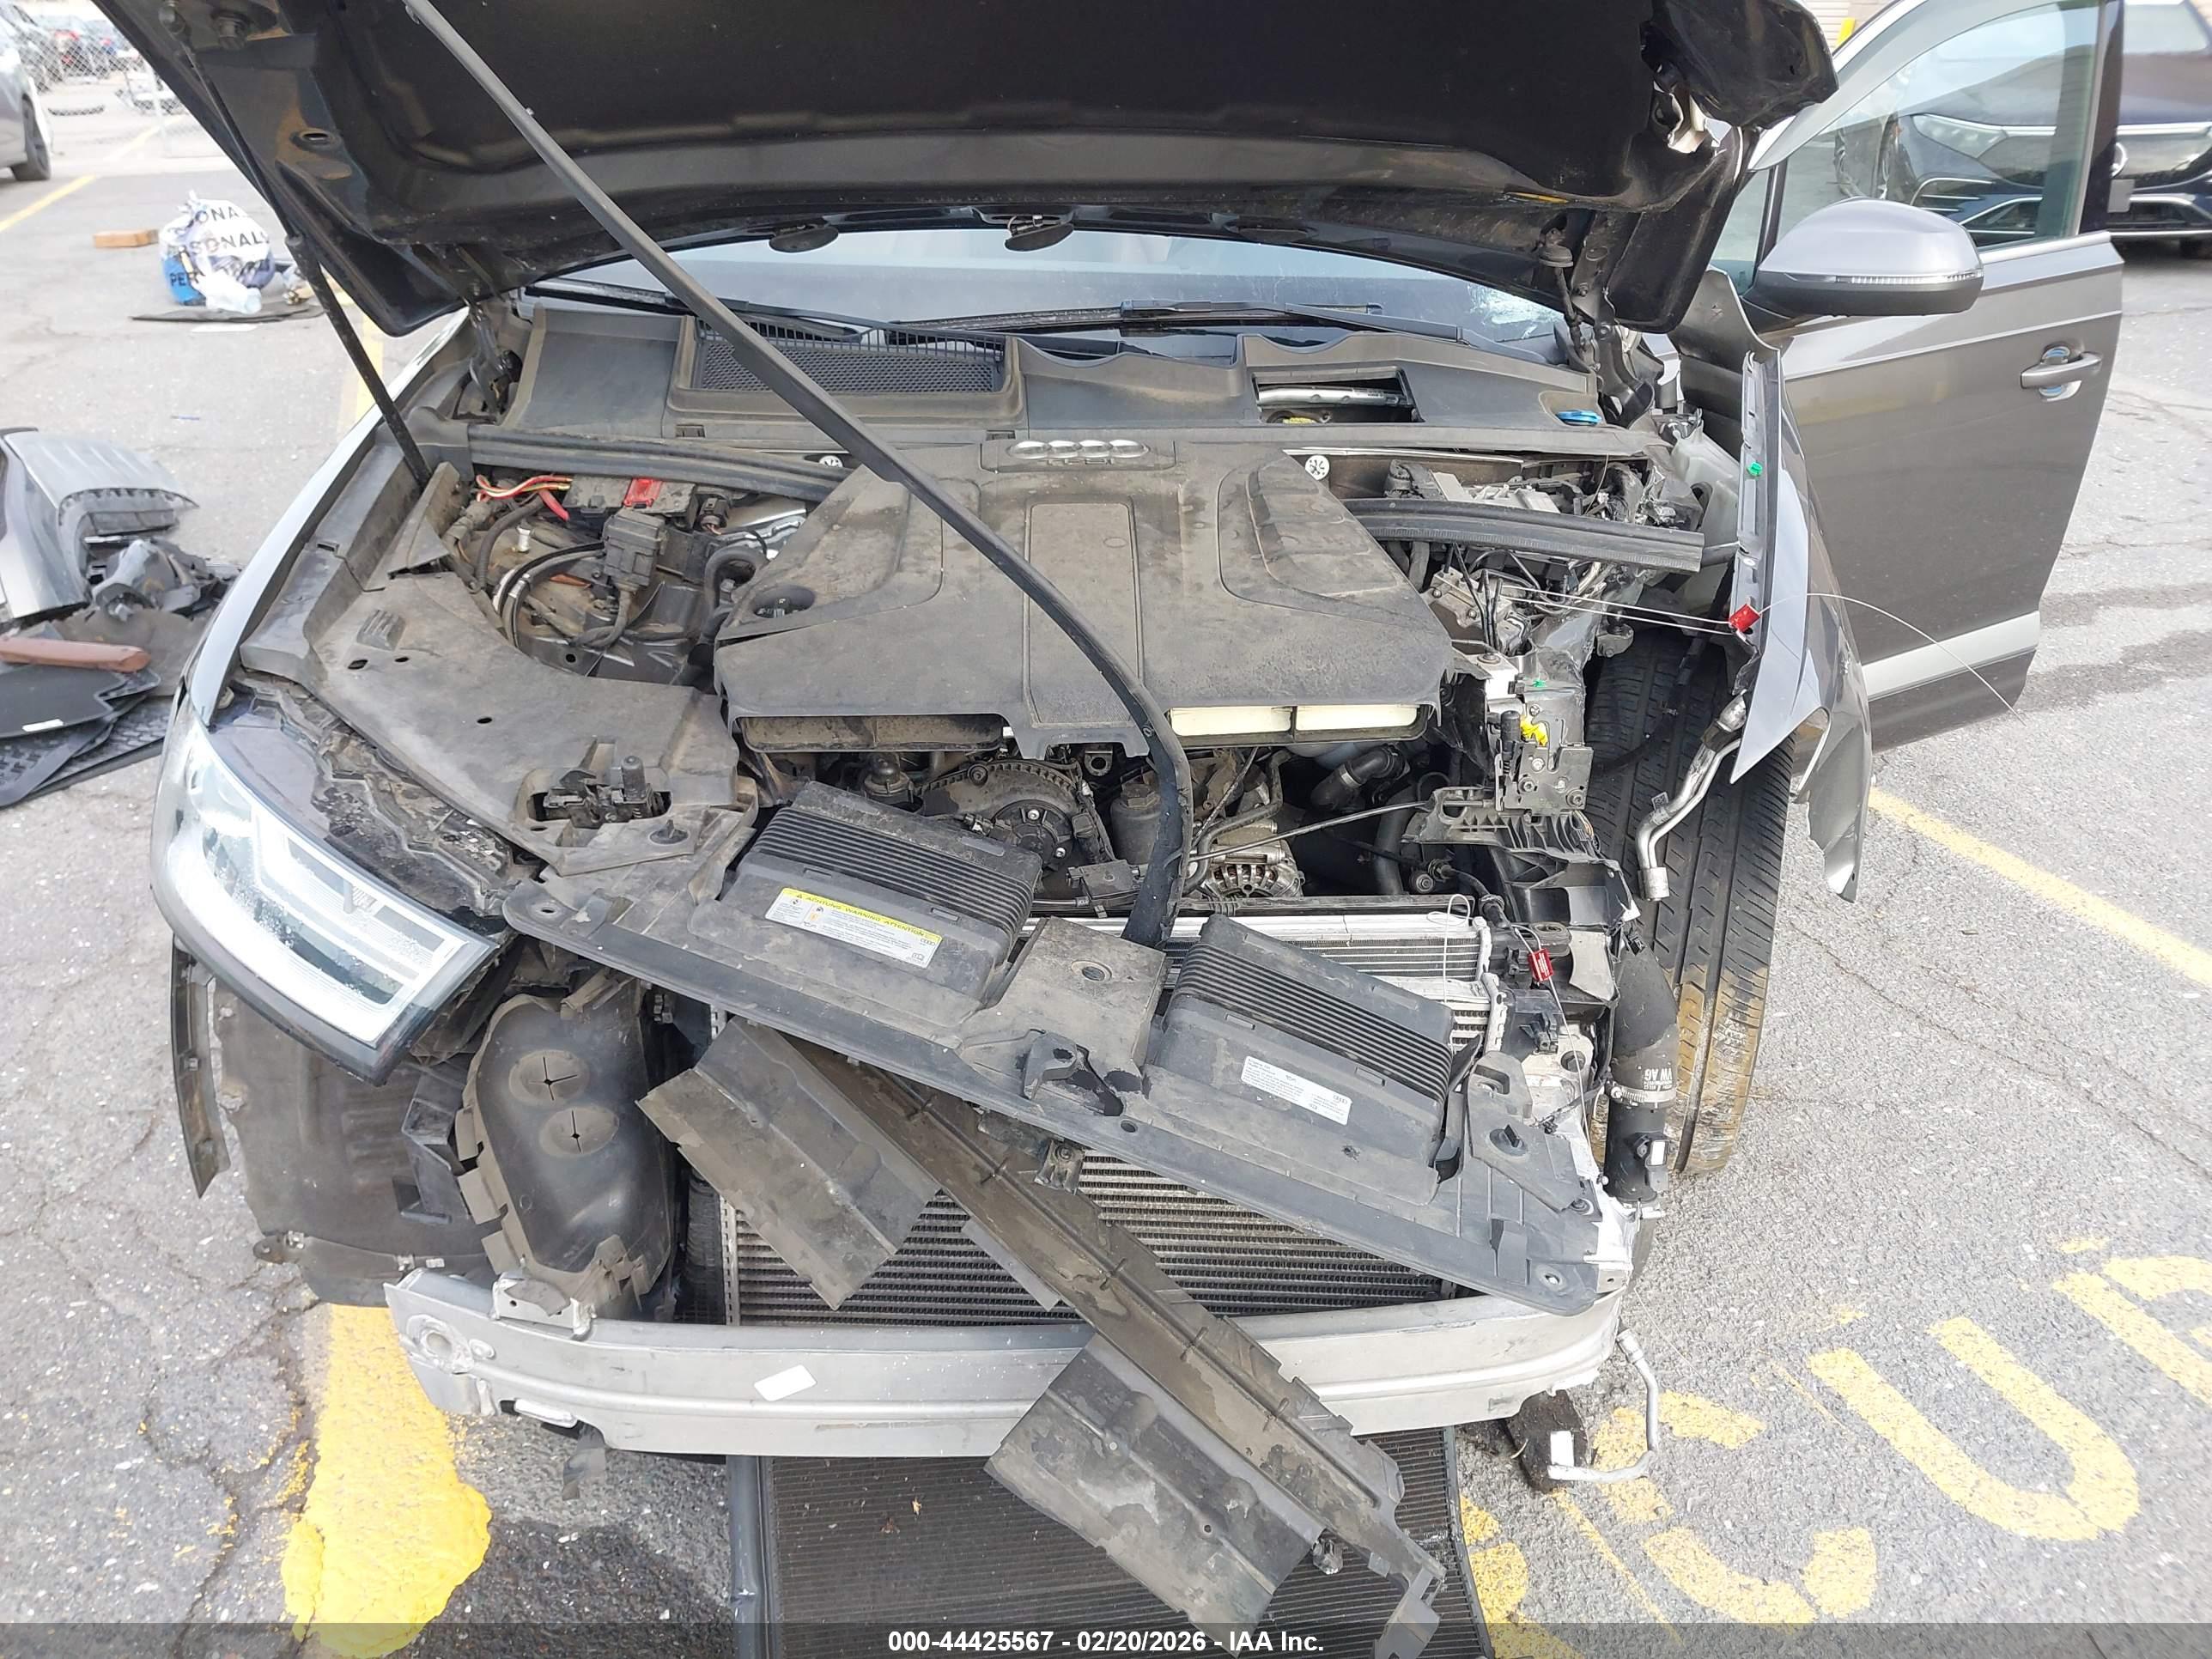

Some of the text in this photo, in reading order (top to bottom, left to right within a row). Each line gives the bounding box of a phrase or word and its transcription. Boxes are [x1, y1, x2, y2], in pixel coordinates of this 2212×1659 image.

[806, 896, 925, 937] ACHTUNG WARNING ATTENTION
[1644, 1067, 1673, 1081] VW AG
